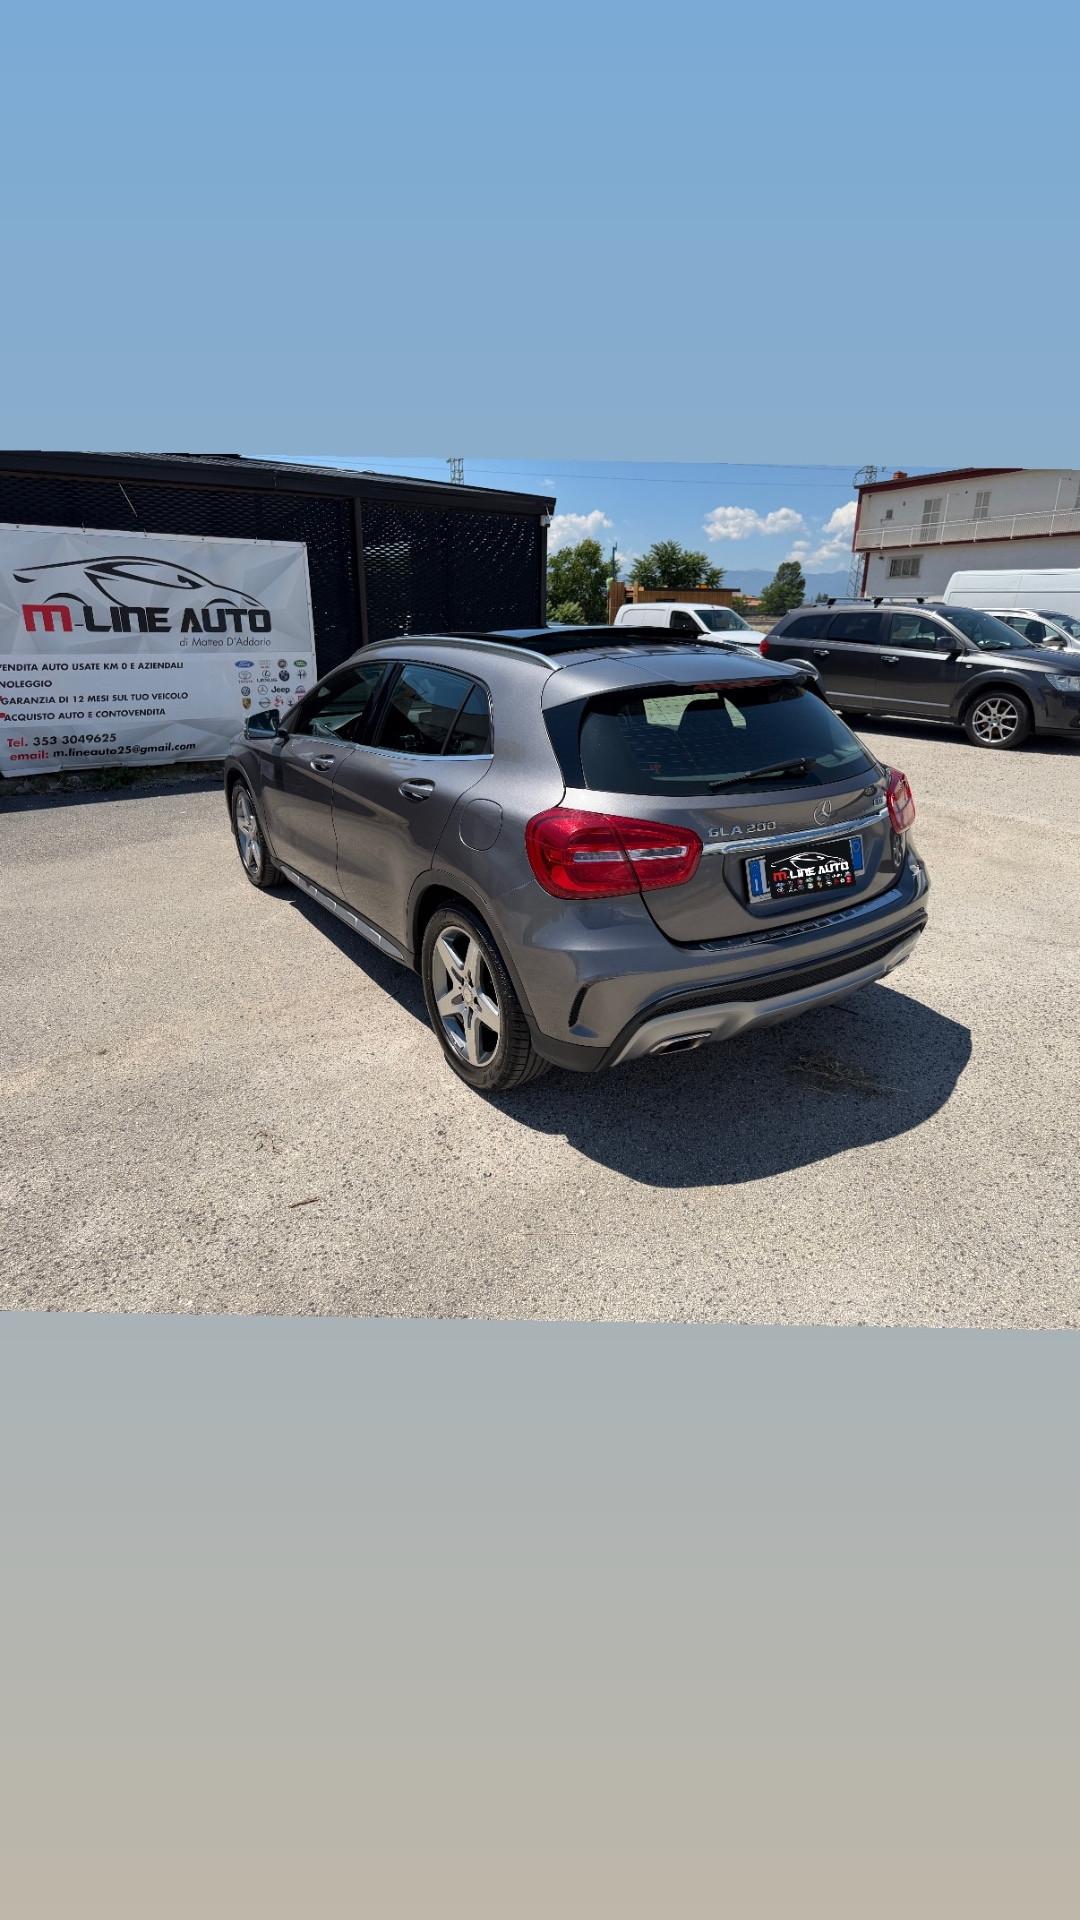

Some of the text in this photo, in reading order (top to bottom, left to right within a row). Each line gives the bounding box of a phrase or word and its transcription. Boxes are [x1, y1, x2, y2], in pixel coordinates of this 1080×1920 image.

[180, 608, 272, 633] AUTO
[179, 637, 272, 647] di Matteo D'Addario
[42, 663, 69, 671] AUTO
[72, 663, 101, 671] USATE
[103, 662, 119, 670] KM
[130, 662, 135, 670] E
[138, 662, 184, 670] AZIENDALI
[0, 680, 53, 688] NOLEGGIO
[271, 686, 290, 694] Jeep
[1, 696, 56, 705] GARANZIA
[73, 695, 84, 703] 12
[87, 694, 109, 702] MESI
[112, 694, 128, 702] SUL
[131, 693, 149, 701] TUO
[151, 692, 189, 700] VEICOLO
[4, 708, 166, 721] ACQUISTO AUTO E CONTOVENDITA
[6, 733, 117, 748] Tel. 353 3049625
[10, 742, 196, 761] email: m.lineauto25@gmail.com
[708, 821, 777, 838] GLA 200
[818, 861, 850, 875] AUTO
